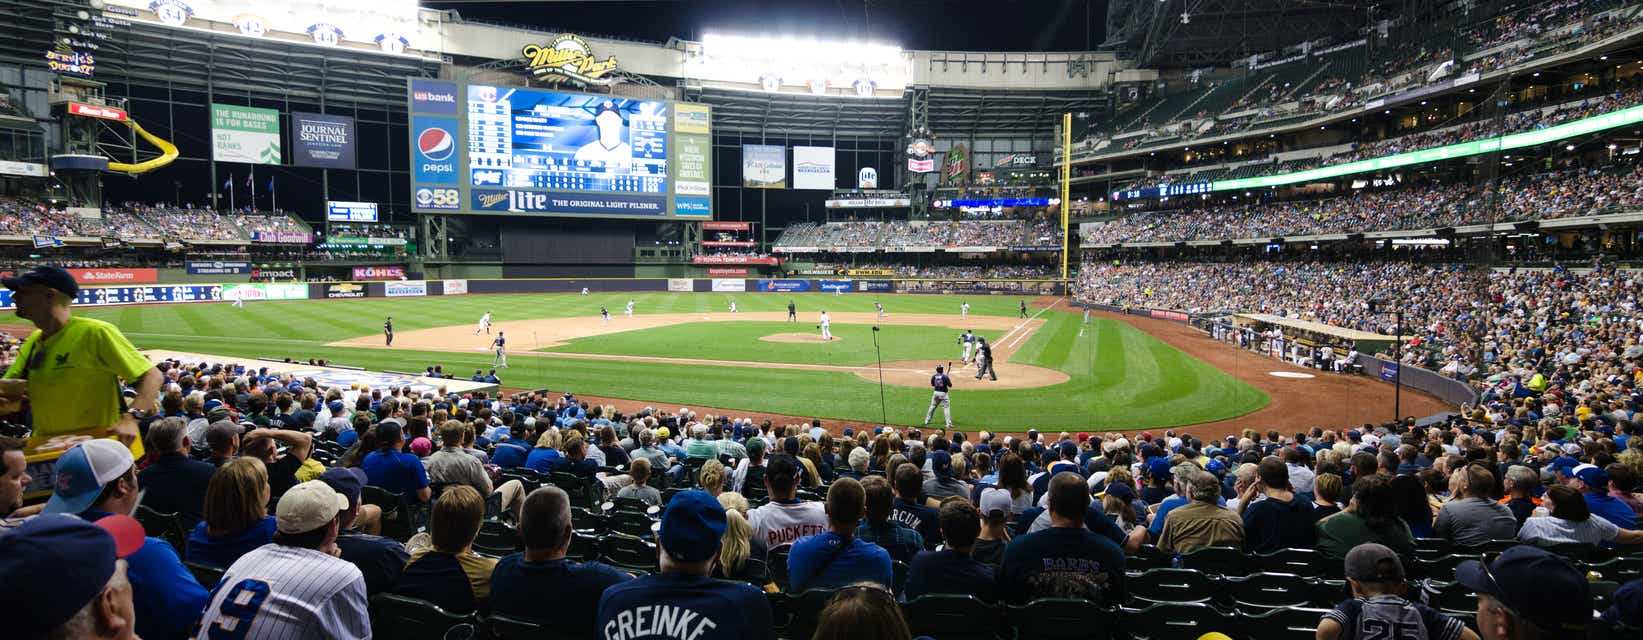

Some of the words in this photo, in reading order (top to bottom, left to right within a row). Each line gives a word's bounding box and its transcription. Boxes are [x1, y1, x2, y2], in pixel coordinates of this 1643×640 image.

[523, 43, 581, 67] Miller
[577, 55, 617, 73] Park
[216, 110, 229, 118] THE
[232, 111, 276, 121] RUNAROUND
[216, 118, 224, 126] IS
[226, 119, 240, 127] FOR
[243, 121, 267, 129] BASES
[301, 124, 347, 136] JOURNAL
[301, 133, 347, 144] SENTINEL
[423, 163, 453, 173] pepsi
[433, 189, 459, 205] 58
[479, 193, 509, 207] Miller
[552, 199, 568, 207] THE
[570, 200, 605, 208] ORIGINAL
[606, 201, 628, 209] LIGHT
[261, 270, 293, 278] impact
[768, 524, 824, 544] PUCKETT
[604, 604, 717, 640] GREINKE
